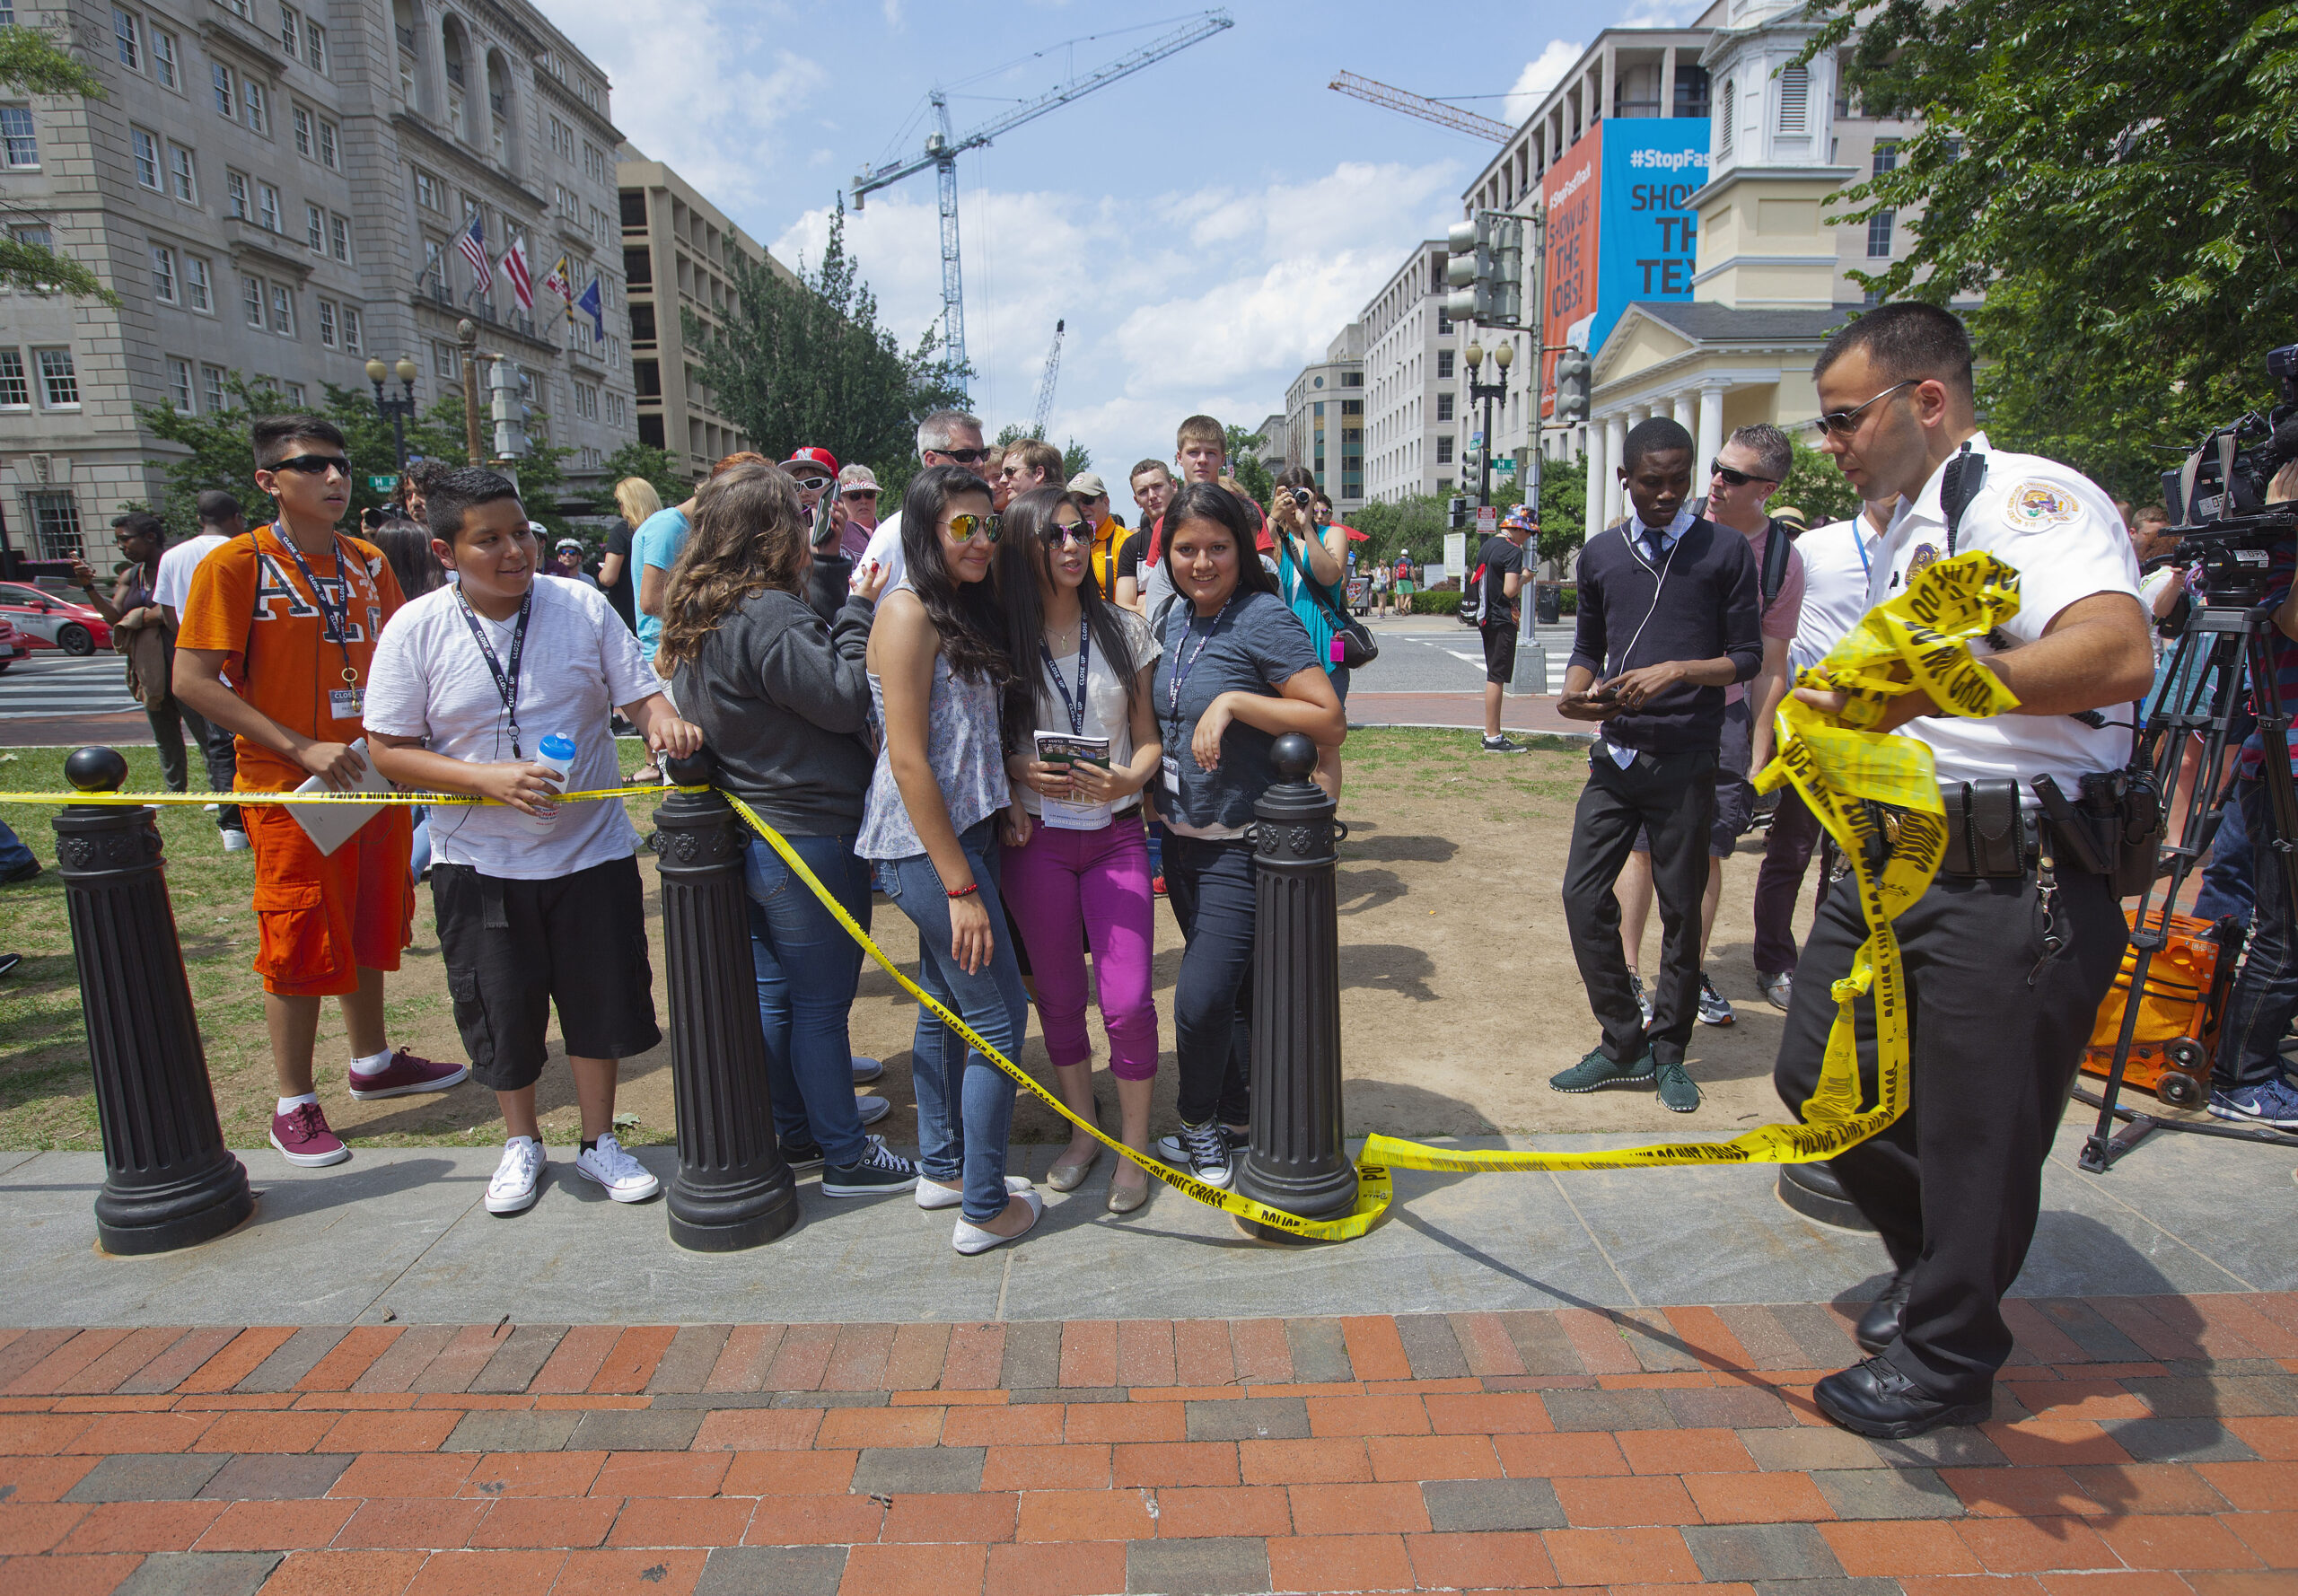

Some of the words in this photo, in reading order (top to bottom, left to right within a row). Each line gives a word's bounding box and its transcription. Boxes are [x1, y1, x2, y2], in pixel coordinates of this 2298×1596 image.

[1630, 149, 1711, 171] #StopFas
[1548, 161, 1592, 211] #StopFastTrack
[1576, 194, 1590, 224] US
[1655, 217, 1697, 252] TH
[1555, 233, 1581, 280] THE
[1552, 269, 1584, 323] JOBS!
[1497, 460, 1504, 469] H
[375, 478, 382, 486] H
[283, 536, 297, 554] CLOSE
[295, 554, 303, 563] UP
[308, 574, 320, 592] CLOSE
[319, 592, 327, 601] UP
[338, 574, 344, 583] UP
[455, 591, 469, 609] CLOSE
[465, 609, 474, 618] UP
[522, 596, 531, 615] CLOSE
[515, 628, 523, 638] UP
[1199, 636, 1206, 645] UP
[477, 630, 490, 649] CLOSE
[486, 649, 495, 660] UP
[512, 639, 522, 660] CLOSE
[1188, 645, 1201, 664] CLOSE
[1080, 654, 1086, 664] UP
[496, 674, 506, 693] CLOS
[509, 675, 516, 685] UP
[1048, 660, 1060, 679] CLOSE
[1057, 680, 1066, 688] UP
[1176, 677, 1182, 687] UP
[334, 691, 353, 699] CLOS
[1171, 688, 1179, 708] CLOSE
[1077, 701, 1083, 711] UP
[1188, 1183, 1229, 1211] CROSS
